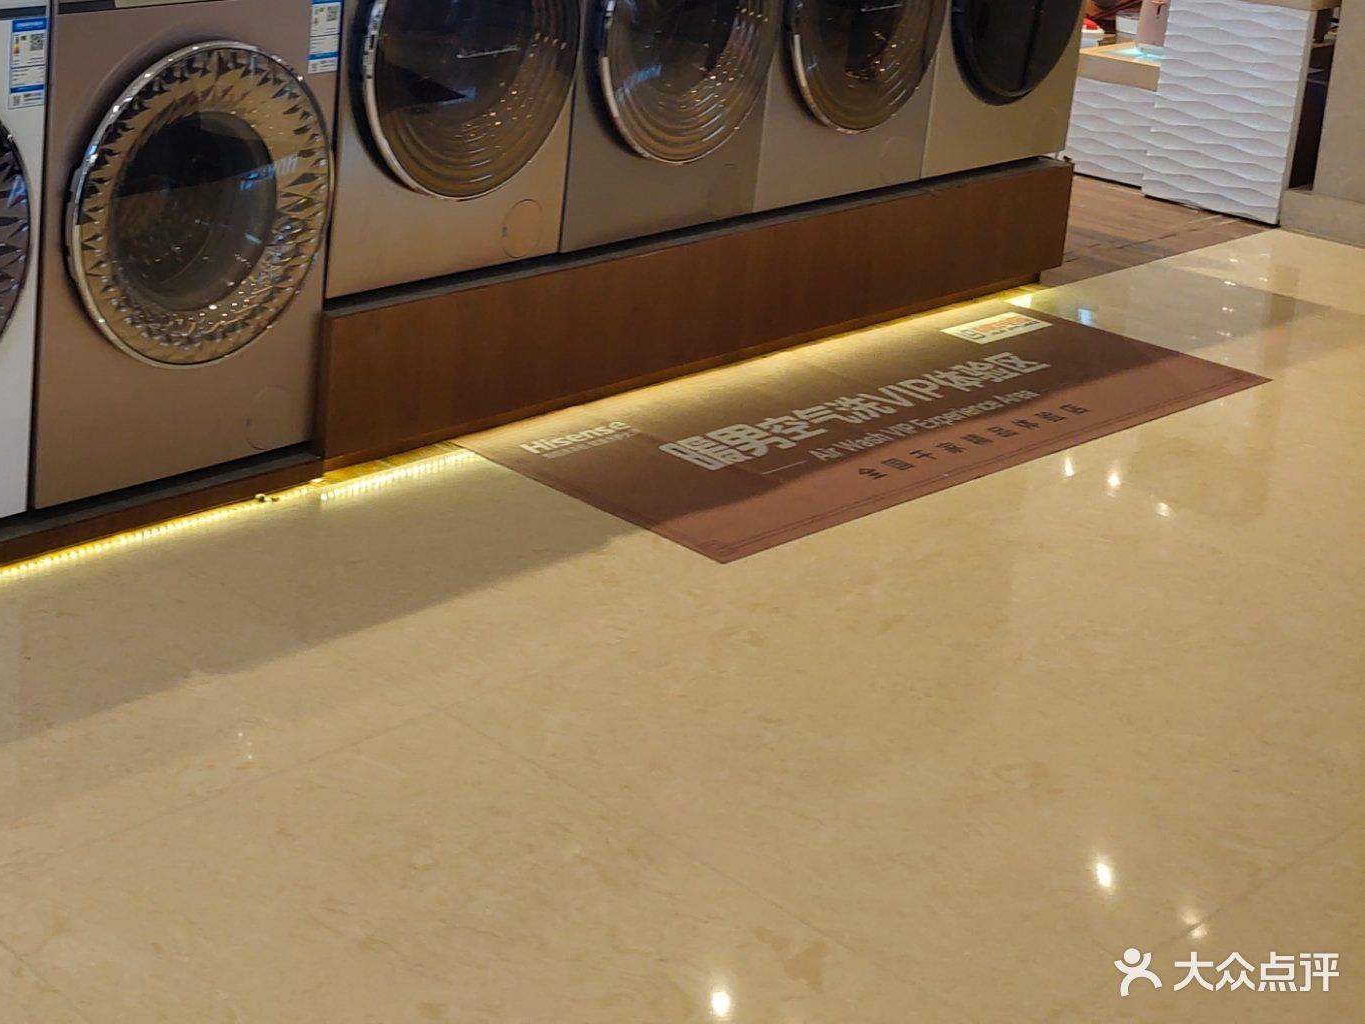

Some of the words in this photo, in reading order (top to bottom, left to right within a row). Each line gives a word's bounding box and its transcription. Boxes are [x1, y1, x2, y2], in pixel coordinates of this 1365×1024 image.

[519, 421, 631, 454] Hisense
[808, 438, 842, 461] Air
[835, 429, 892, 452] Wash
[888, 419, 917, 439] VIP
[912, 399, 1001, 431] Experience
[997, 390, 1040, 404] Area
